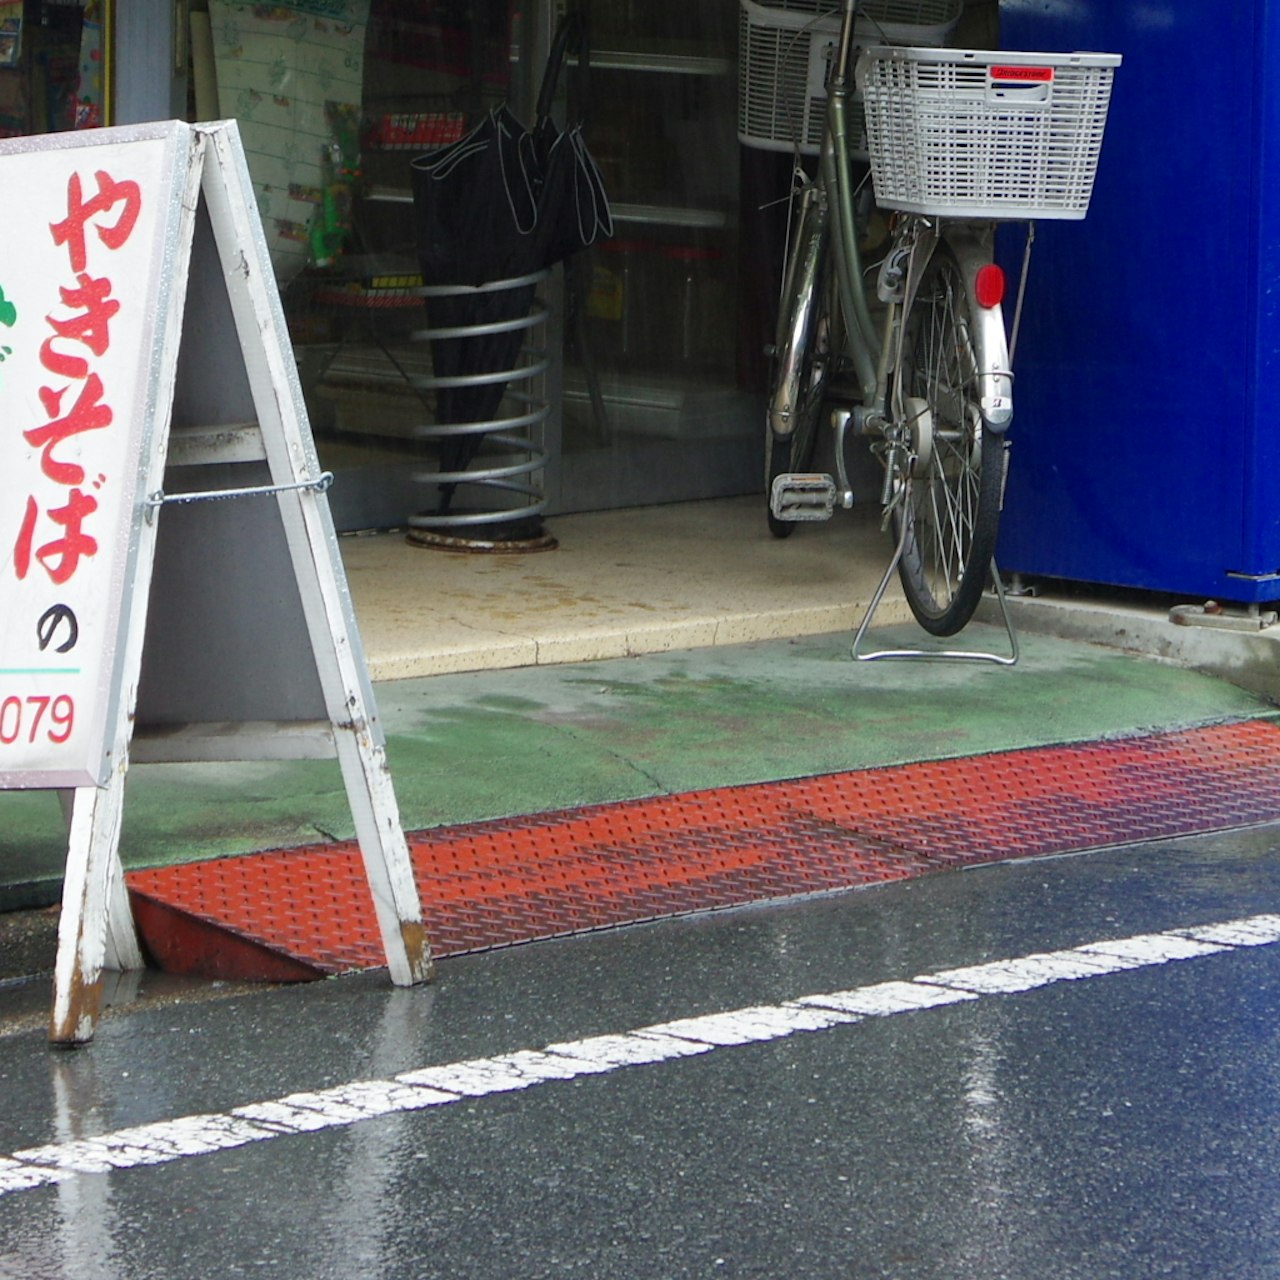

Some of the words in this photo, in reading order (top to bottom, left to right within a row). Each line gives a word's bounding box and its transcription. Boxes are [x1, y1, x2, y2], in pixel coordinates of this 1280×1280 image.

[14, 169, 143, 654] やきそばの
